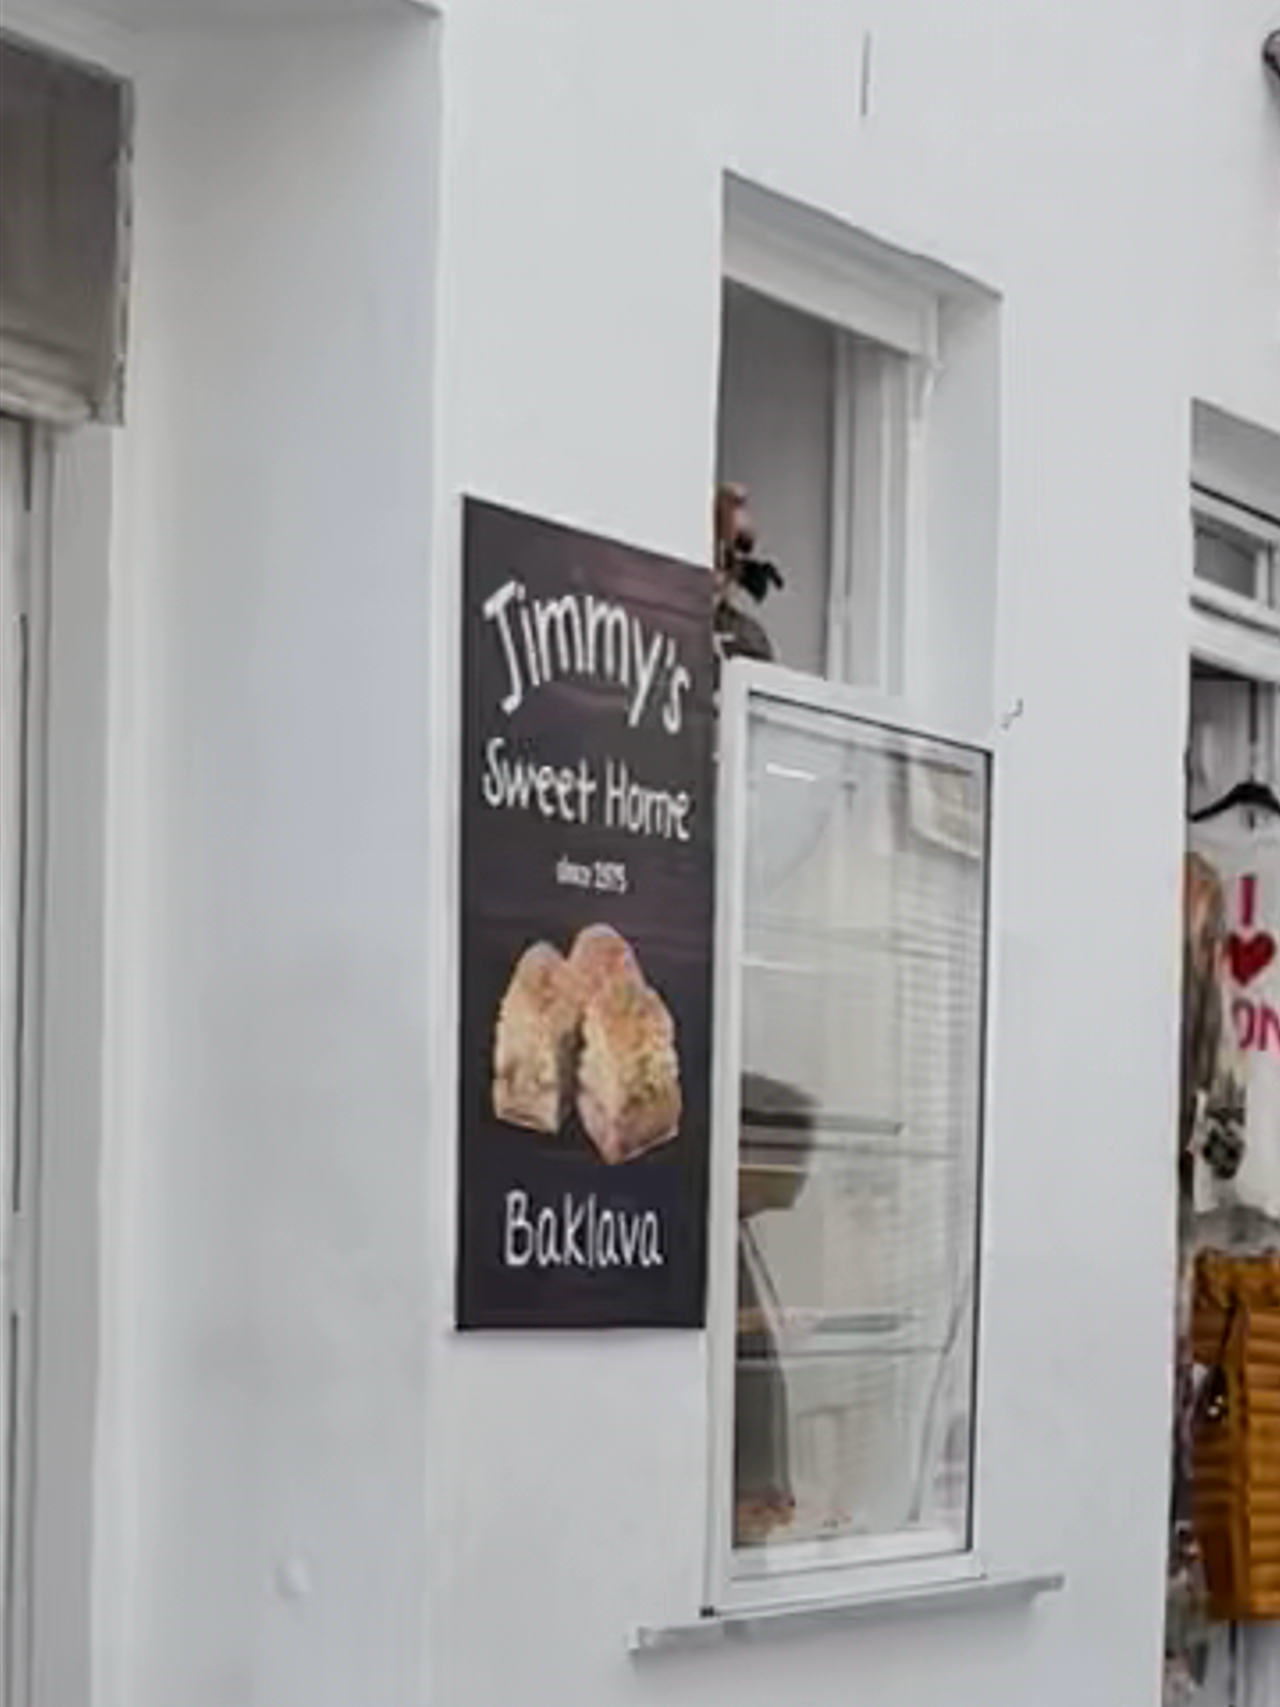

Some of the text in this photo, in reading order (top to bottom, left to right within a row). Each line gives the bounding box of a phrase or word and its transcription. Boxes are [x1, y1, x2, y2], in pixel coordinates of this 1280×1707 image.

[483, 580, 691, 733] Jimmy's
[482, 737, 690, 841] Sweet Home
[1240, 873, 1257, 927] I
[504, 1188, 665, 1269] Baklava
